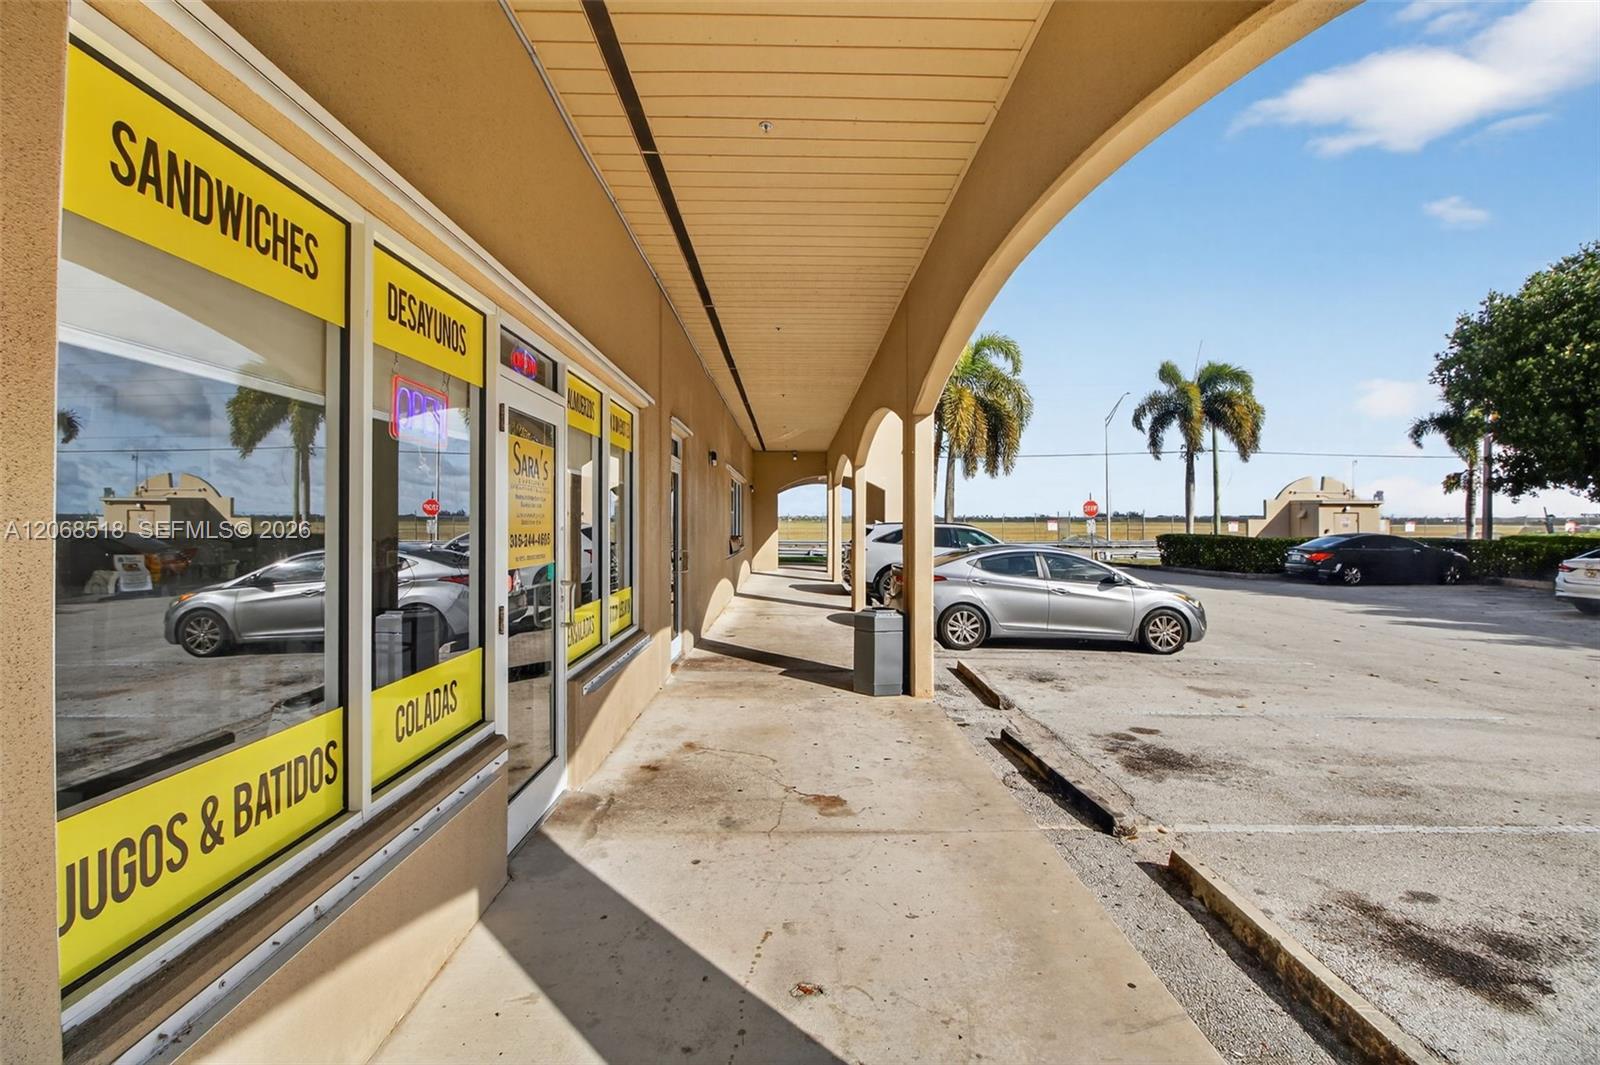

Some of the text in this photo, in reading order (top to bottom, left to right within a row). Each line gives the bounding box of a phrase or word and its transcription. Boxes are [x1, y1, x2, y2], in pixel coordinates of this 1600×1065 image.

[110, 120, 319, 280] SANDWICHES
[387, 281, 467, 356] DESAYUNOS
[397, 386, 448, 440] OPEN
[395, 680, 458, 743] COLADAS
[58, 740, 338, 938] JUGOS & BATIDOS
